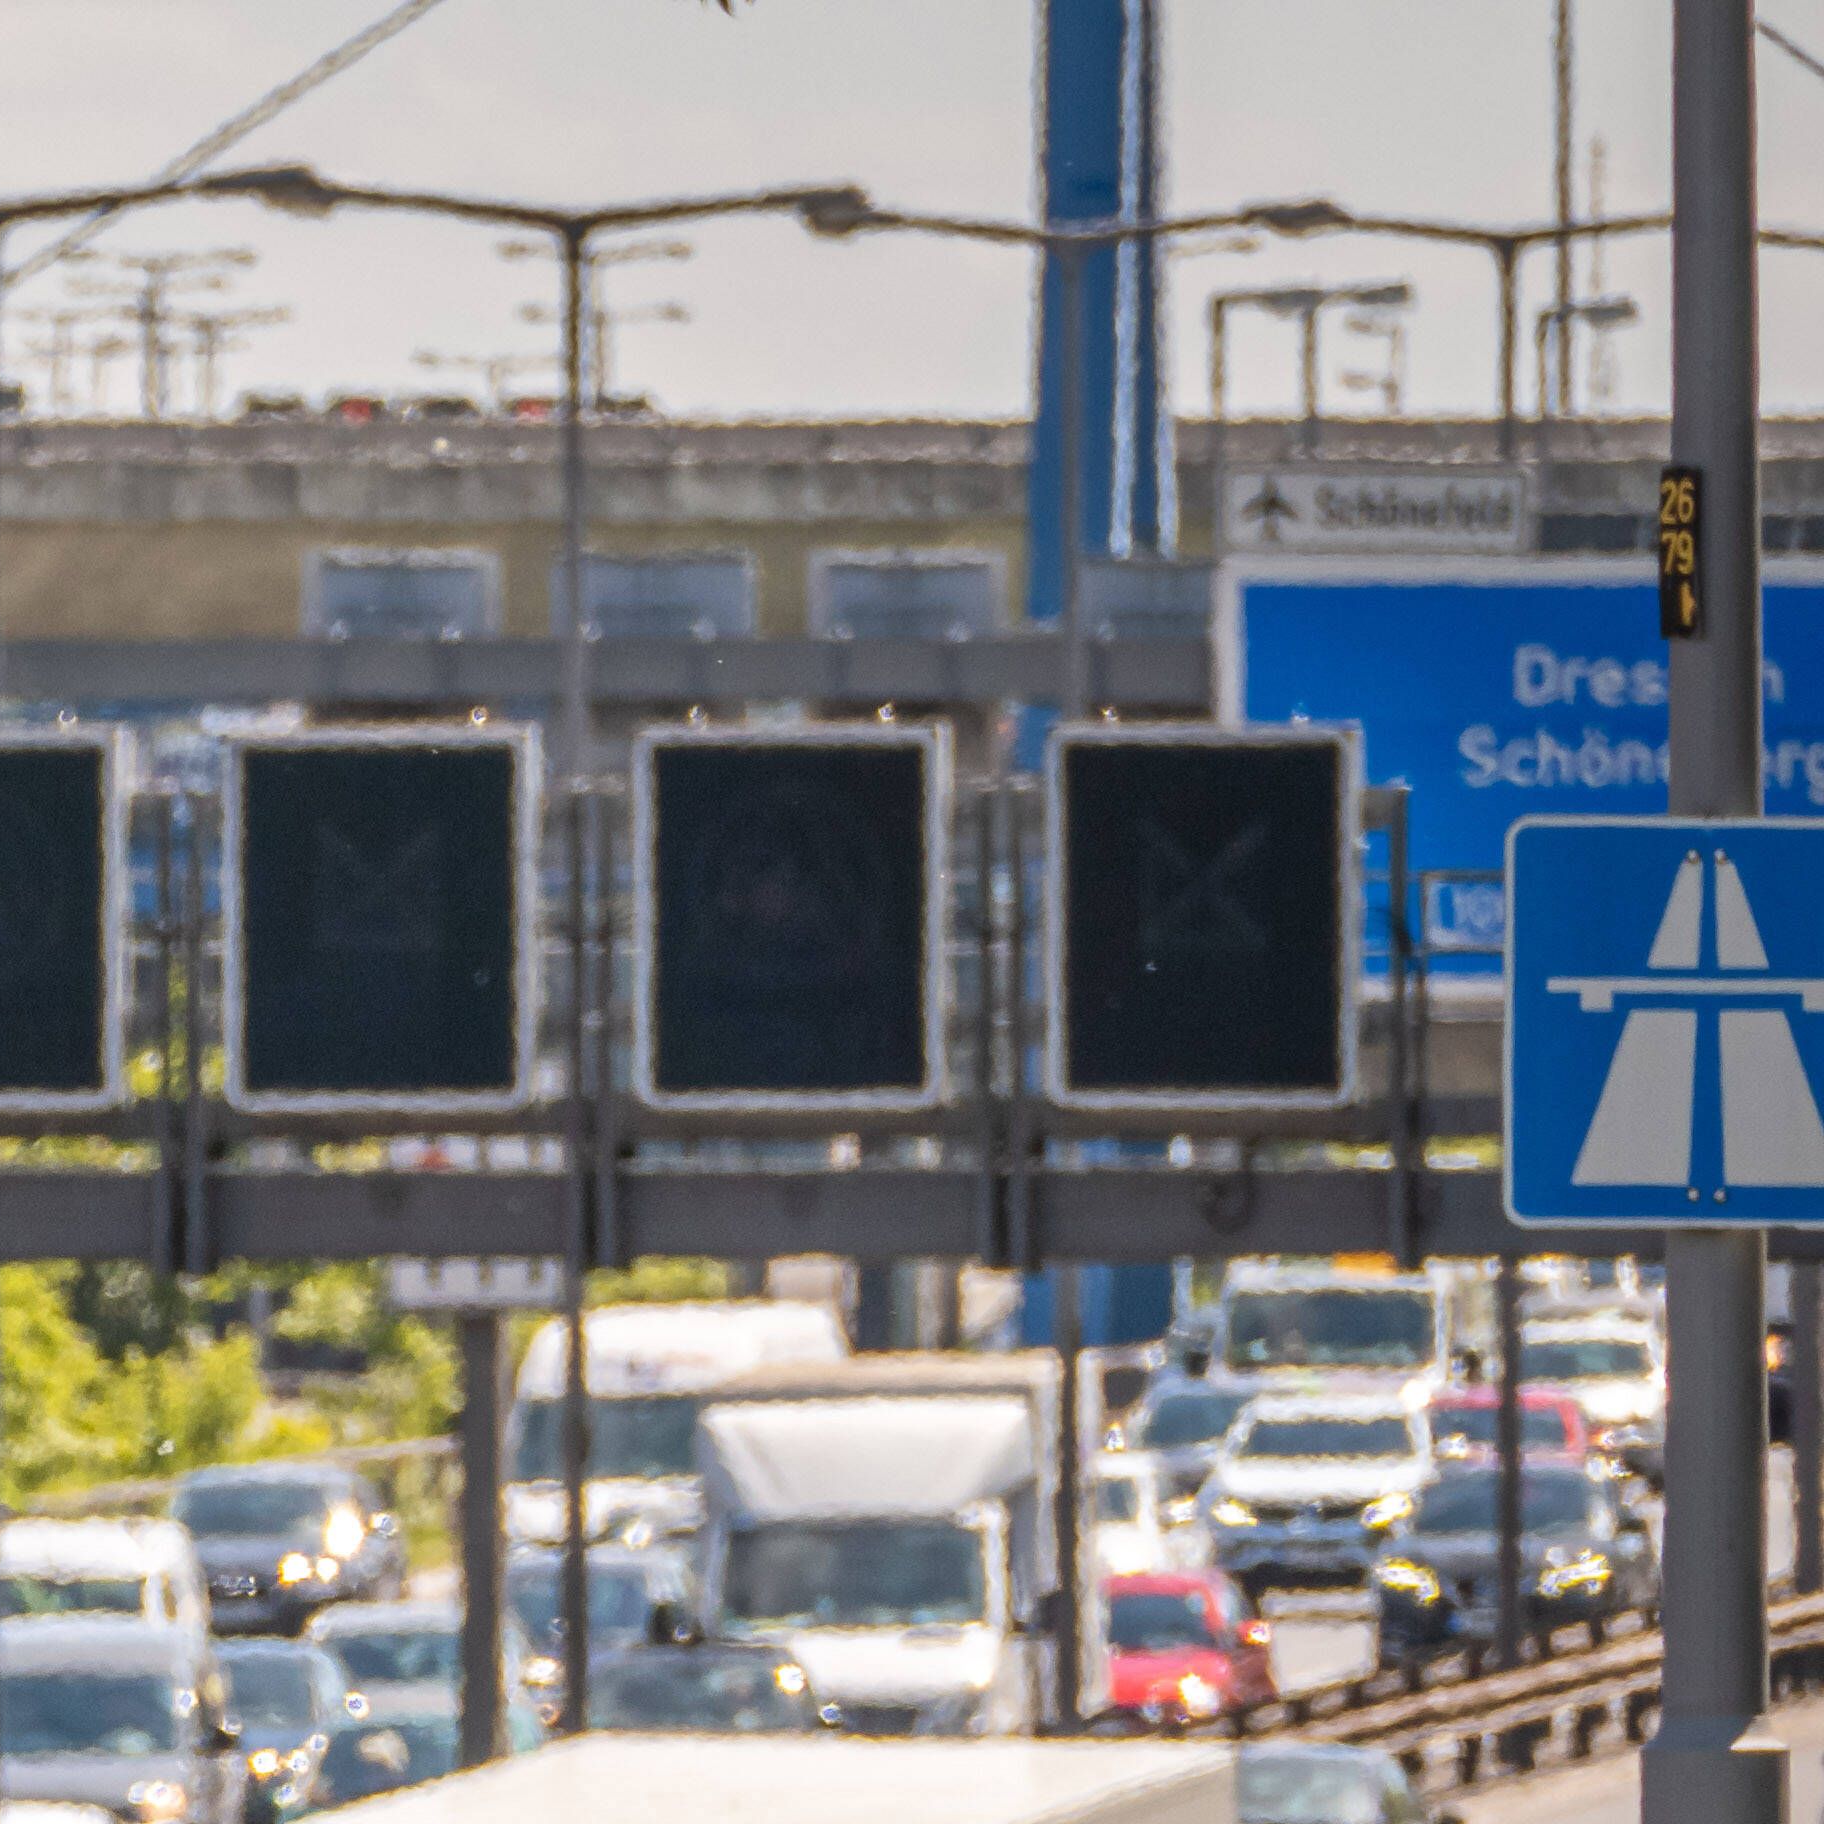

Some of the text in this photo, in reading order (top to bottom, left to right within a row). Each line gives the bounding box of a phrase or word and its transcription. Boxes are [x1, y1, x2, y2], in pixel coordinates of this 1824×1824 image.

[1660, 477, 1695, 524] 26
[1661, 529, 1694, 575] 79
[1512, 643, 1785, 707] Dresn
